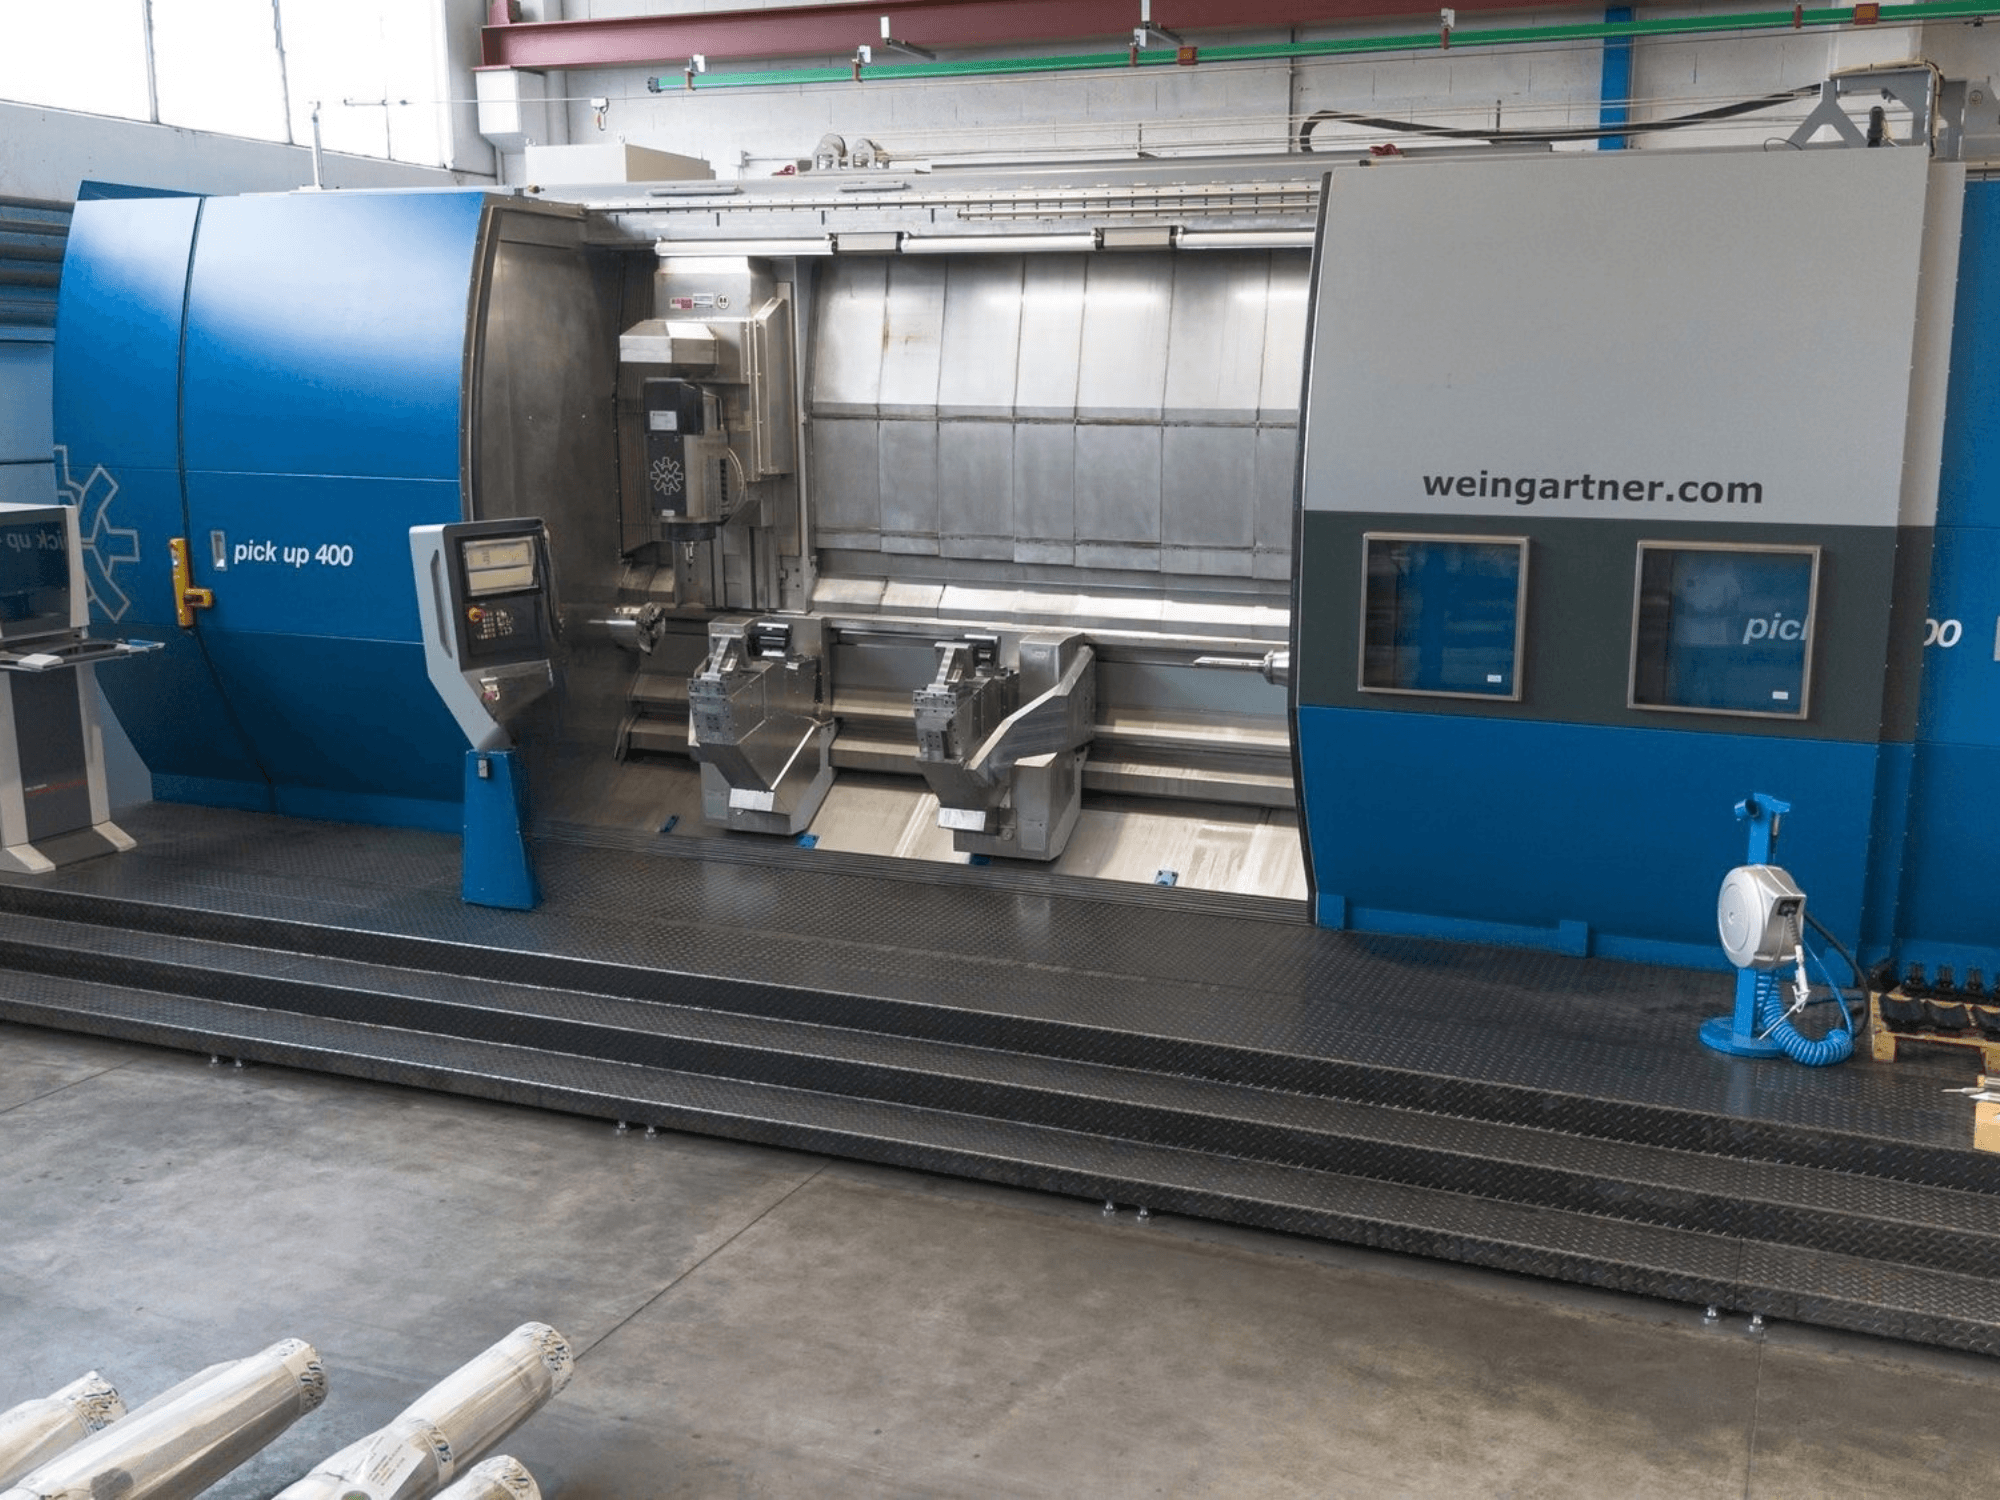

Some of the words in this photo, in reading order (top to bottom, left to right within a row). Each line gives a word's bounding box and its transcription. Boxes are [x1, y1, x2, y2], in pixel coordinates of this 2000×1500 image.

[1422, 470, 1763, 505] weingartner.com
[234, 539, 278, 565] pick
[283, 546, 310, 569] up
[314, 543, 354, 567] 400
